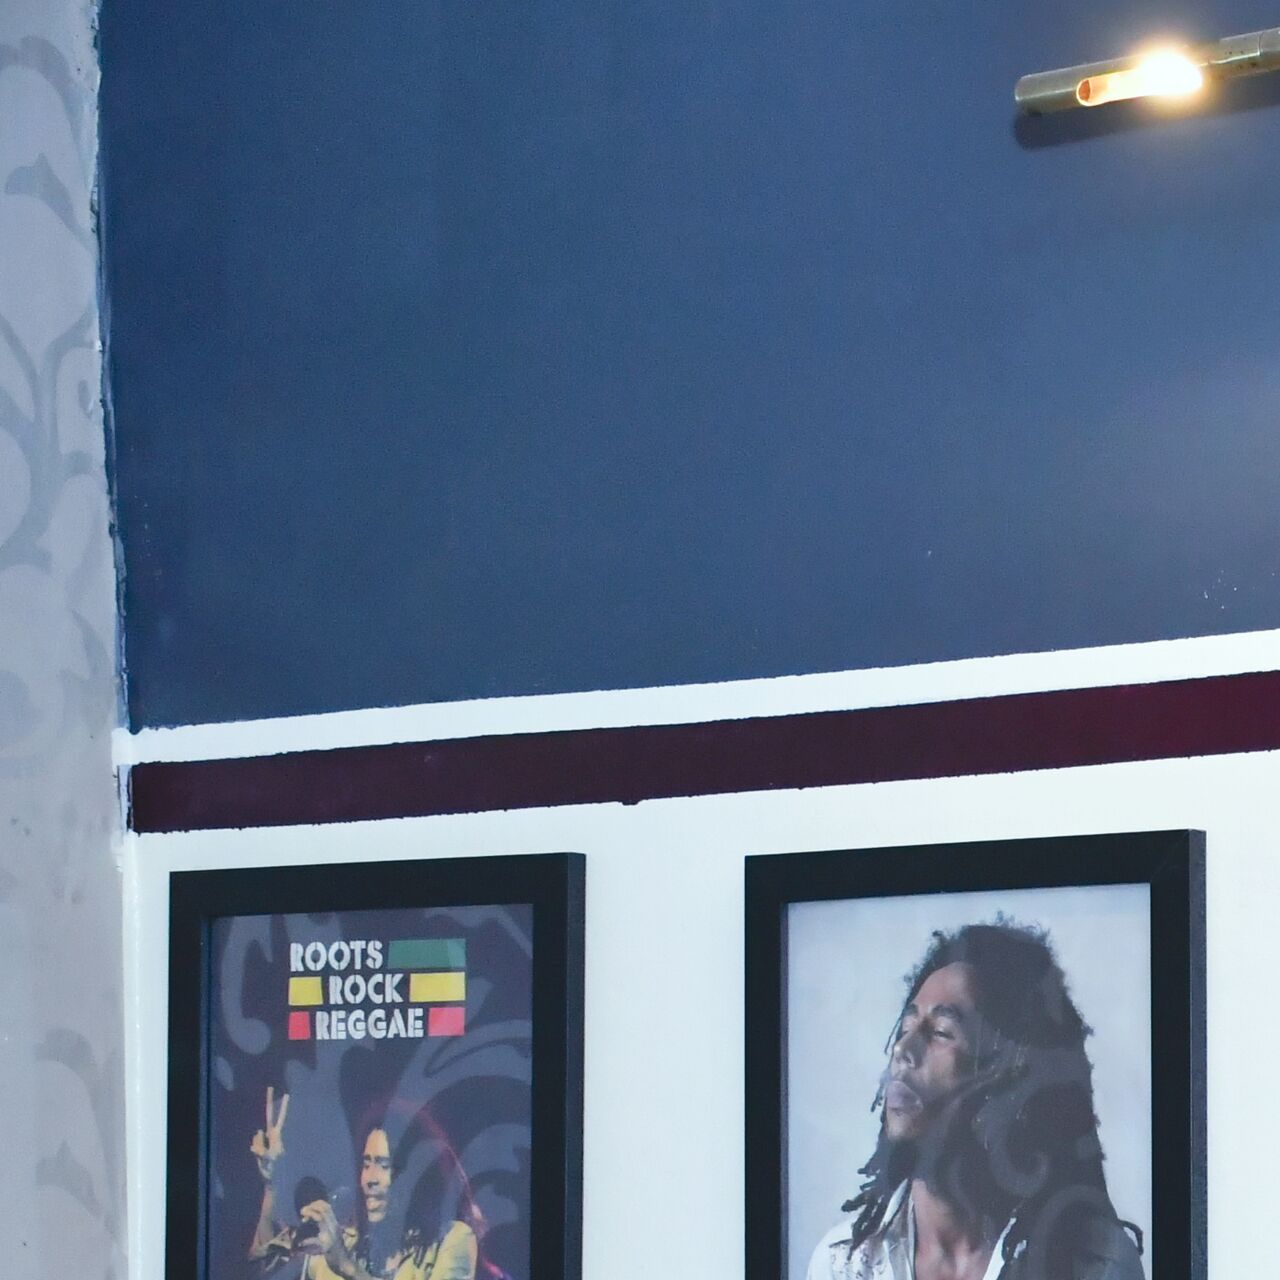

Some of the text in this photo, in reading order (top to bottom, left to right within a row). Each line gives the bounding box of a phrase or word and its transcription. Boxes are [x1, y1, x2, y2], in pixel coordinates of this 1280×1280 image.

[289, 940, 383, 972] ROOTS
[329, 973, 404, 1004] ROCK
[315, 1008, 424, 1040] REGGAE
